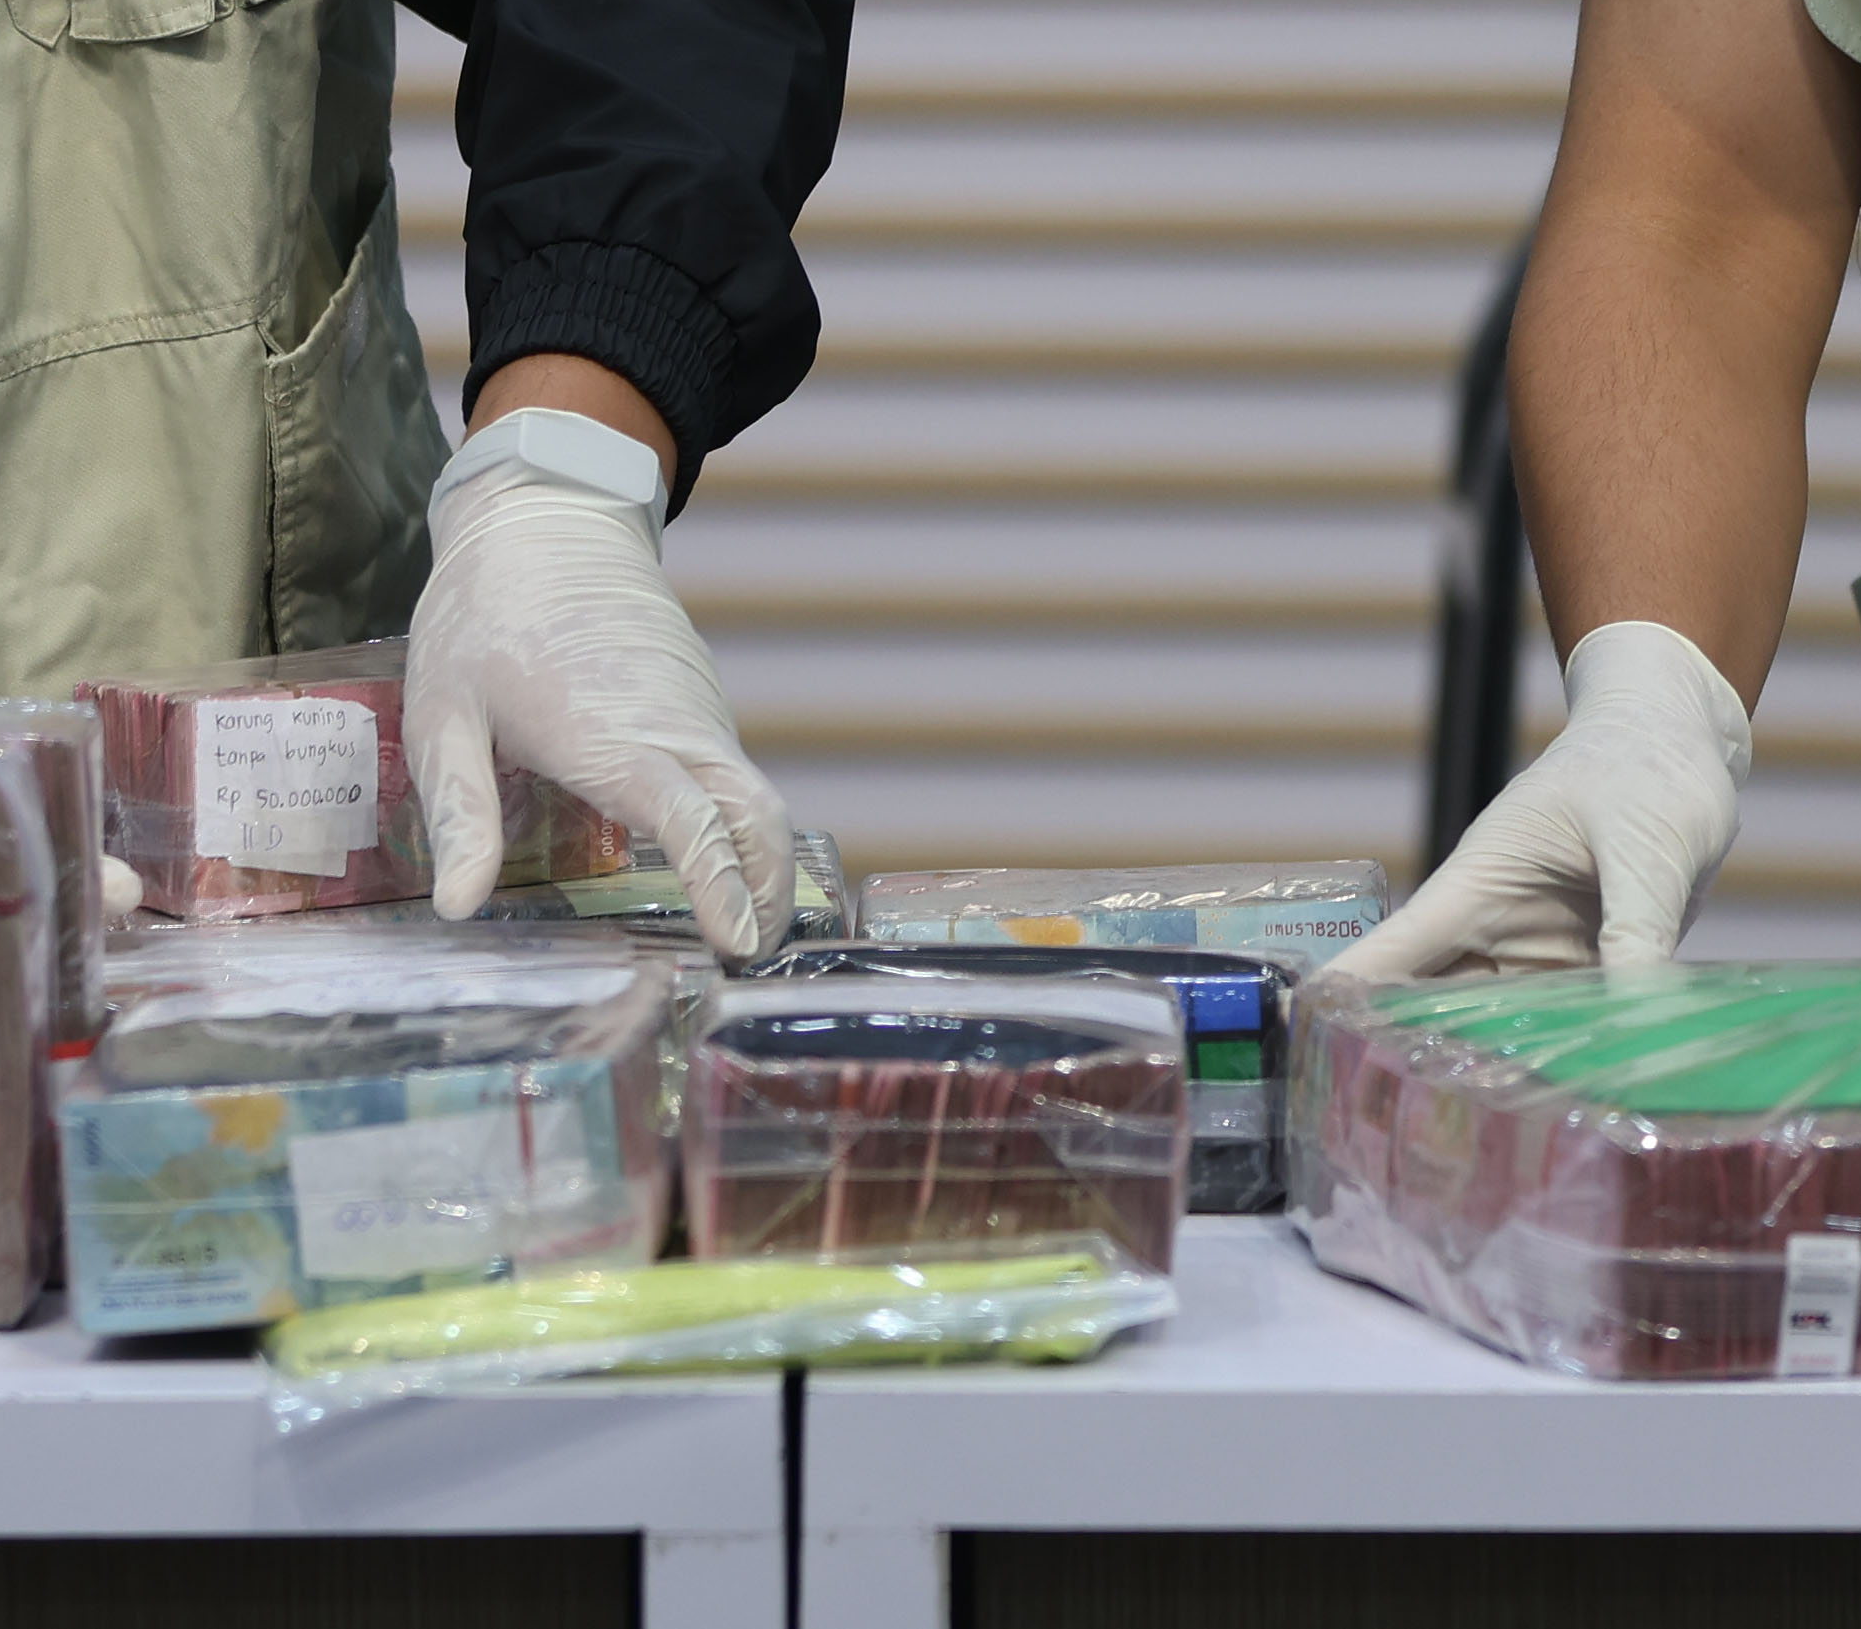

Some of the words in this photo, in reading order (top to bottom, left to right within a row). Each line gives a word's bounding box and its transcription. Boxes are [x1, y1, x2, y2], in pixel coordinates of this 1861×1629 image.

[285, 740, 356, 767] bungkus
[216, 785, 242, 813] Rp
[256, 783, 363, 809] 50.000.000
